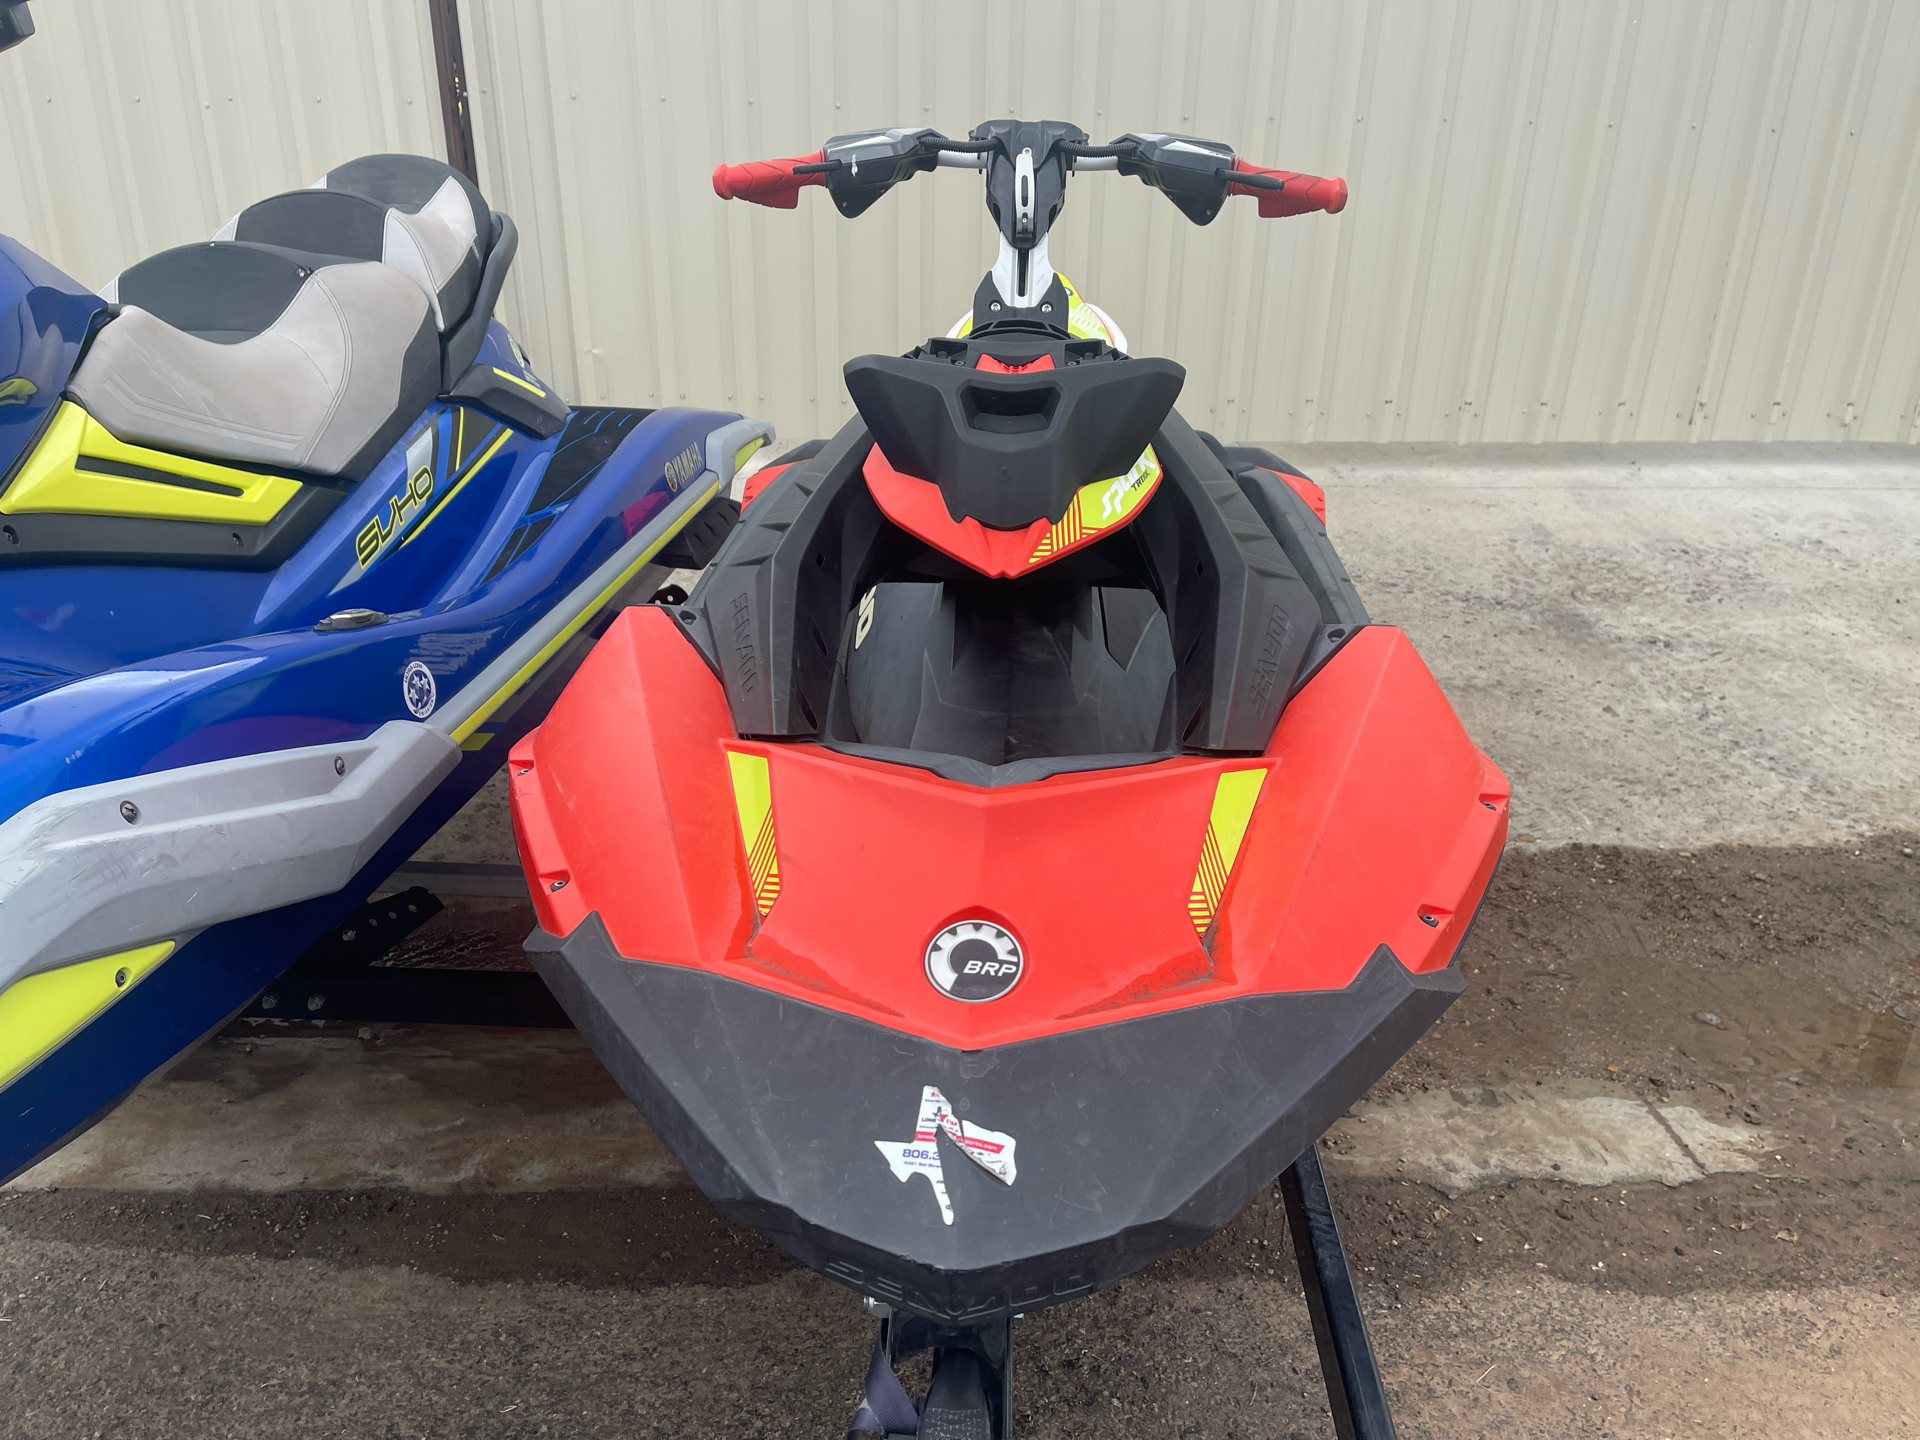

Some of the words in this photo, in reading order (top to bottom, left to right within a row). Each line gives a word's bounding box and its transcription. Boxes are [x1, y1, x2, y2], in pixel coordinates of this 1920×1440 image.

[671, 441, 704, 485] YAMAHA
[1130, 469, 1151, 491] TRIXX
[356, 465, 434, 570] SVHO
[963, 960, 1017, 977] BRP
